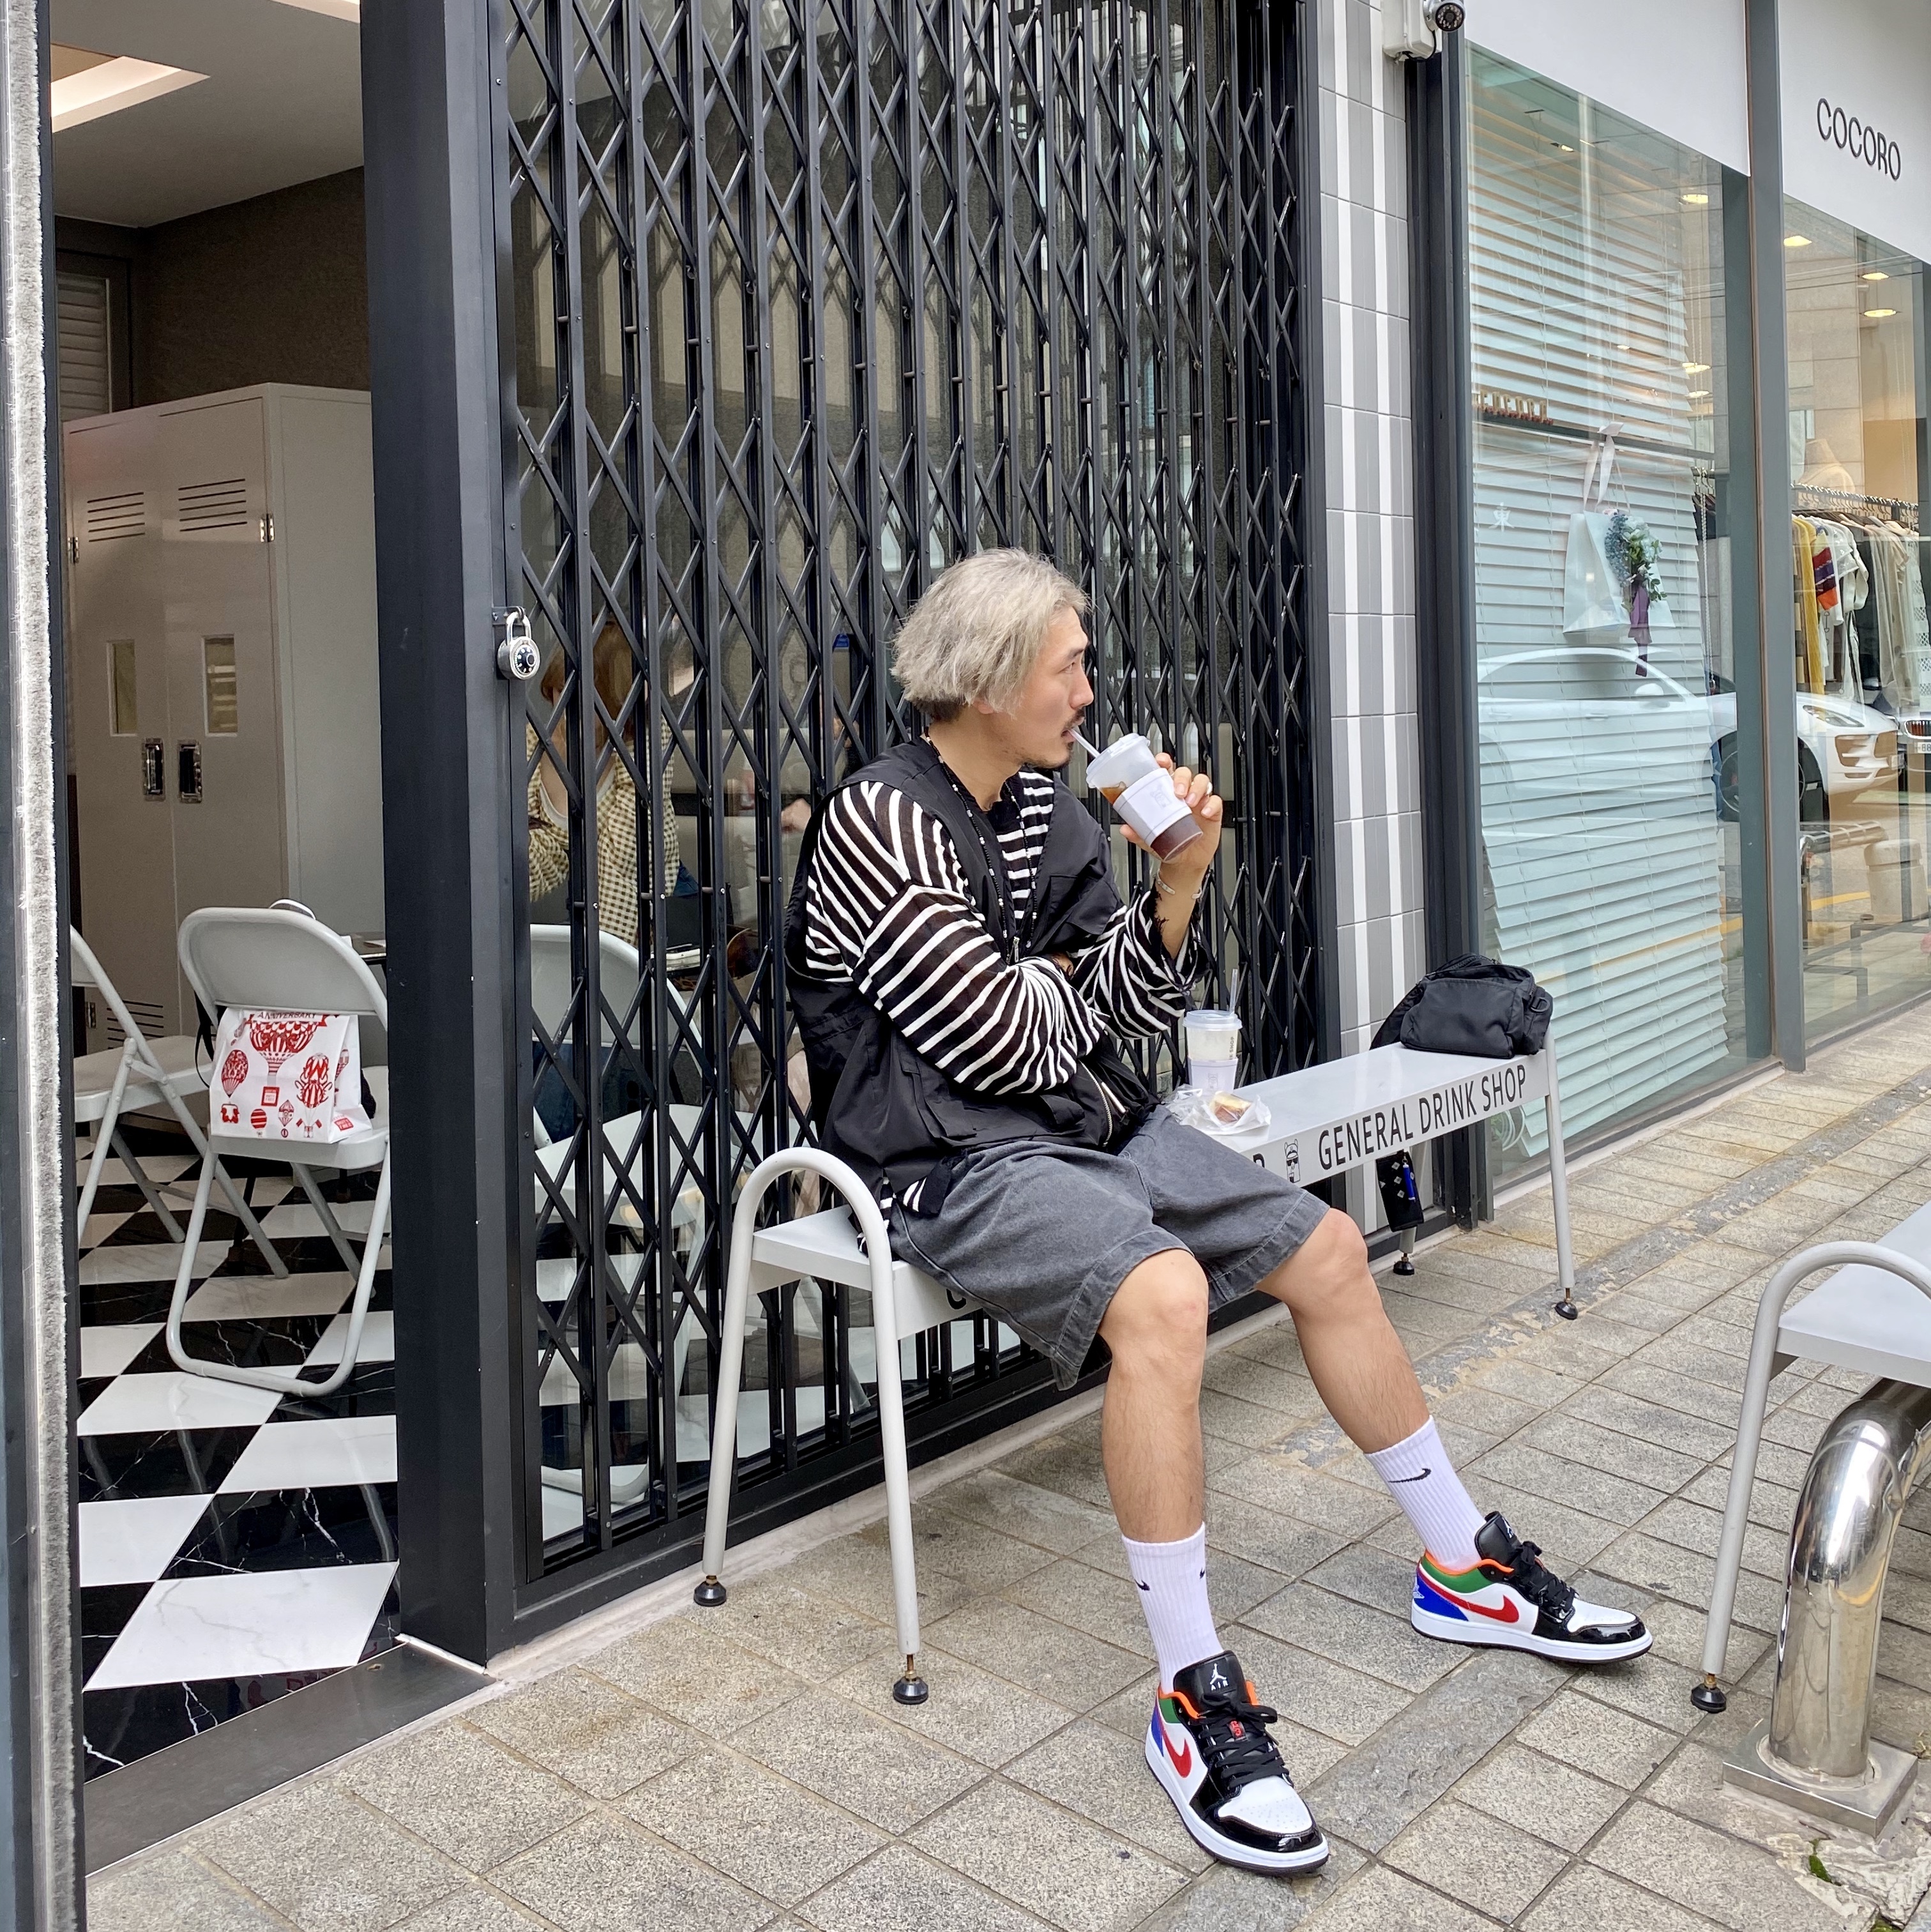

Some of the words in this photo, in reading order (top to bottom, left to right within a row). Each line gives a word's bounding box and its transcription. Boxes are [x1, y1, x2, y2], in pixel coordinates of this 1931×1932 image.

[1817, 98, 1901, 181] COCORO
[1319, 1104, 1414, 1171] GENERAL
[1419, 1080, 1477, 1134] DRINK
[1481, 1064, 1526, 1113] SHOP
[1211, 1680, 1229, 1691] AIR
